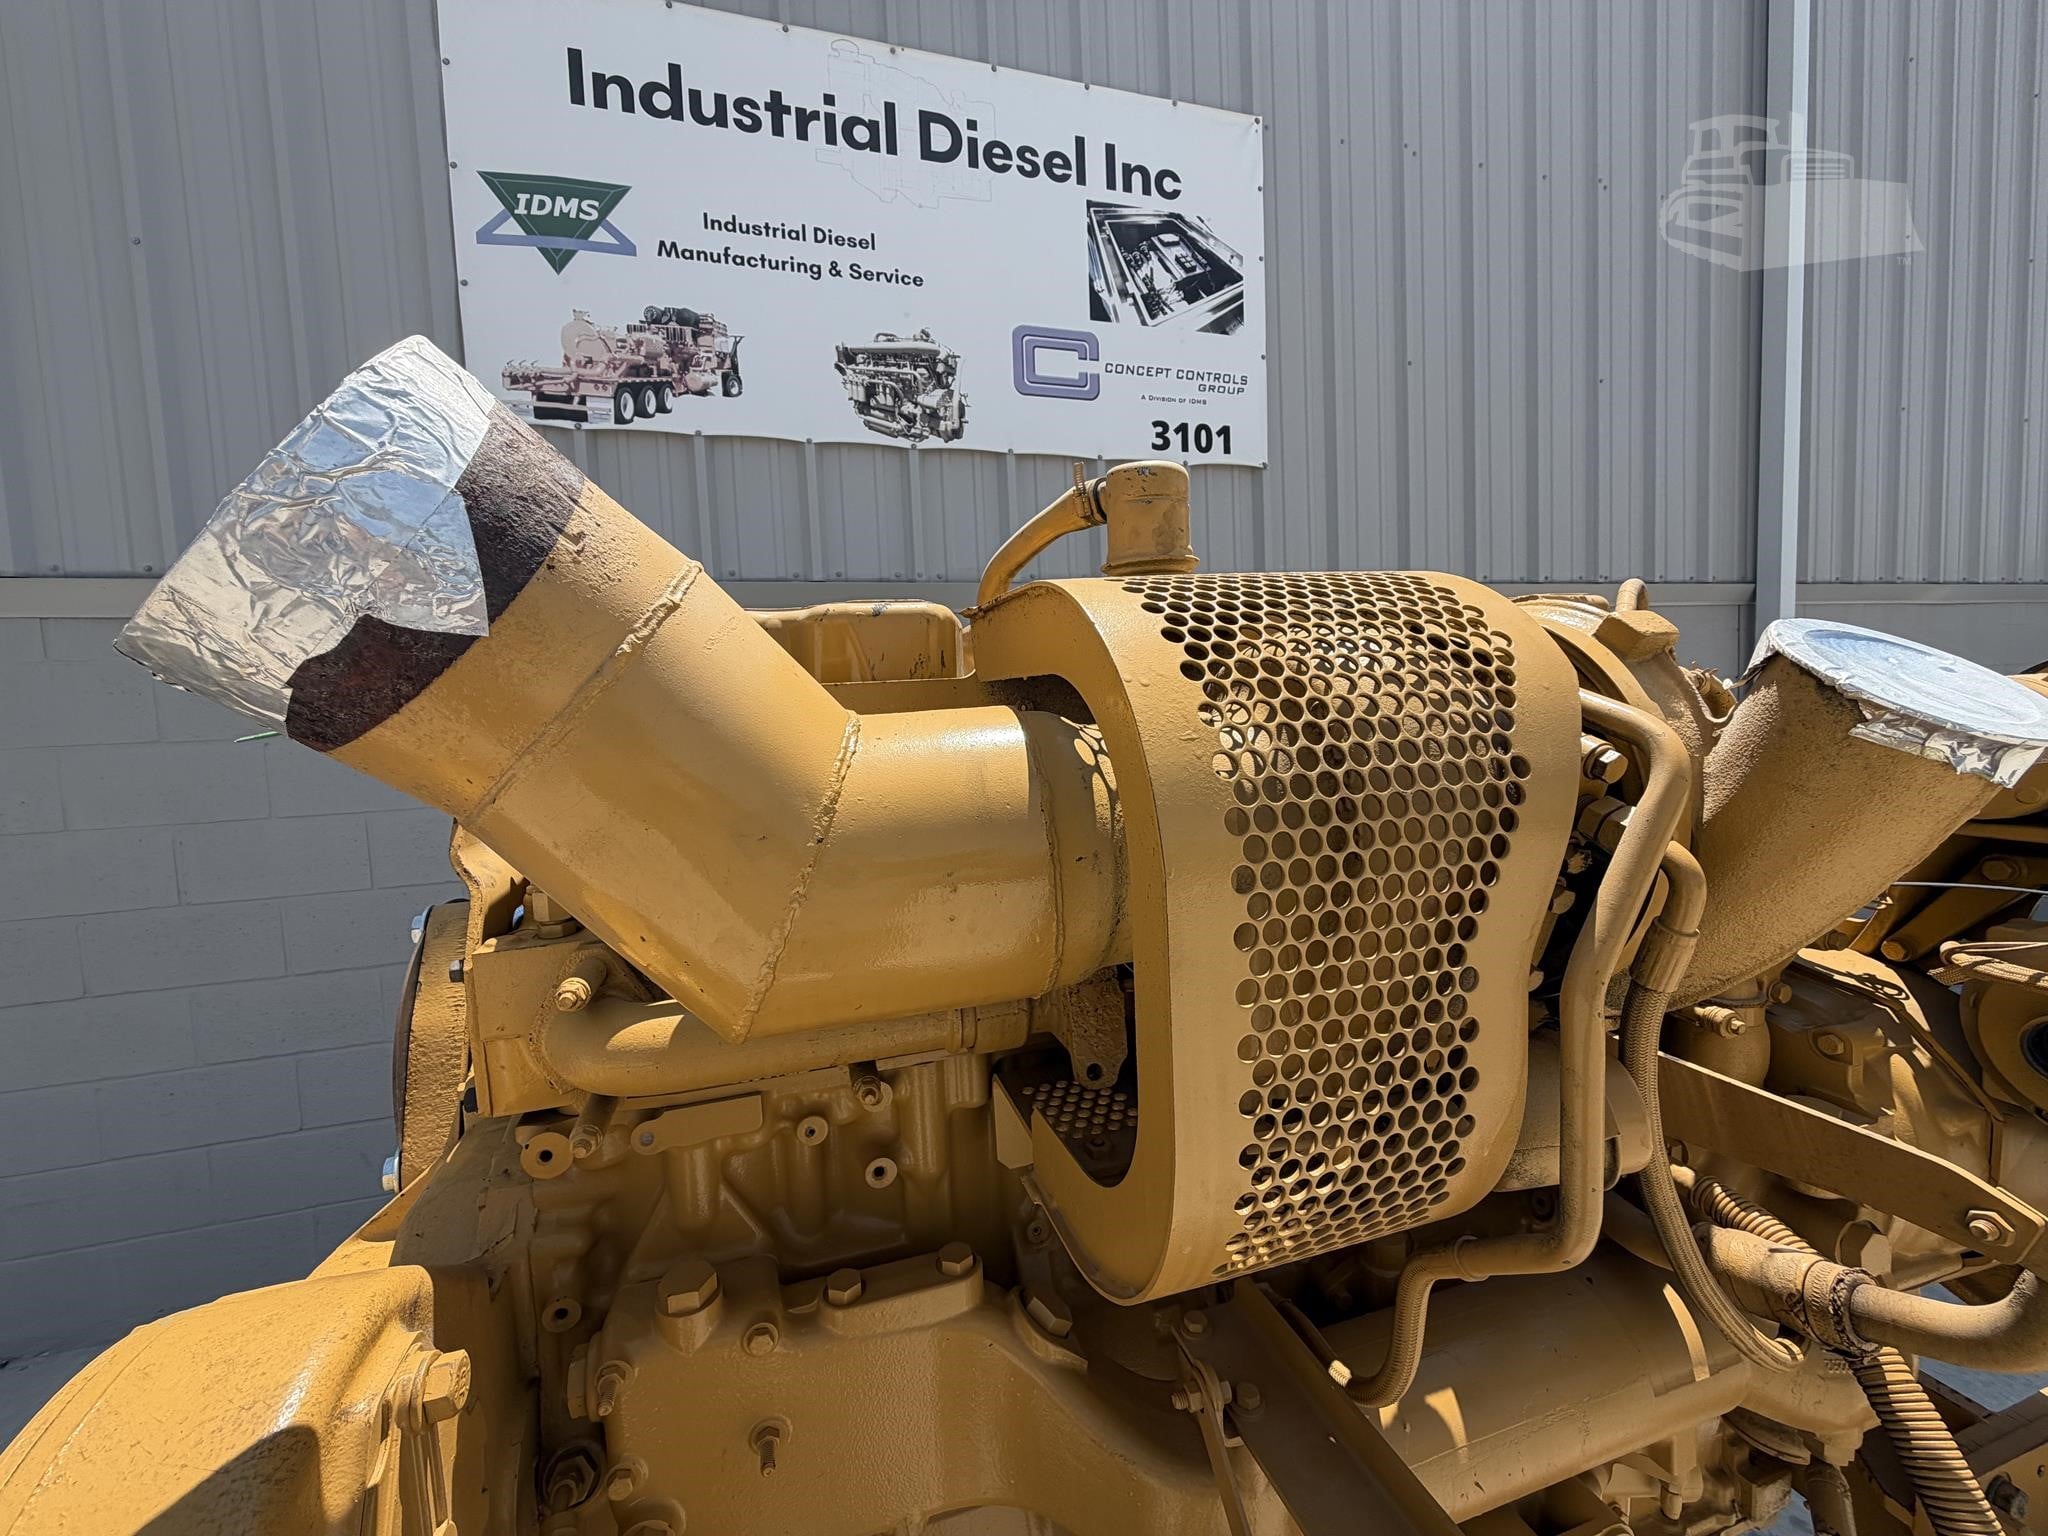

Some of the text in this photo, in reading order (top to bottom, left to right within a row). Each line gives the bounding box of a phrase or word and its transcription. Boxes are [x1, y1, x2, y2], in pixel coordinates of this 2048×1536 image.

[567, 47, 1183, 201] Industrial Diesel Inc
[514, 193, 600, 221] IDMS
[703, 212, 876, 251] Industrial Diesel
[657, 239, 925, 288] Manufacturing & Service
[1104, 362, 1249, 386] CONCEPT CONTROLS
[1198, 383, 1245, 395] GROUP
[1151, 420, 1232, 455] 3101
